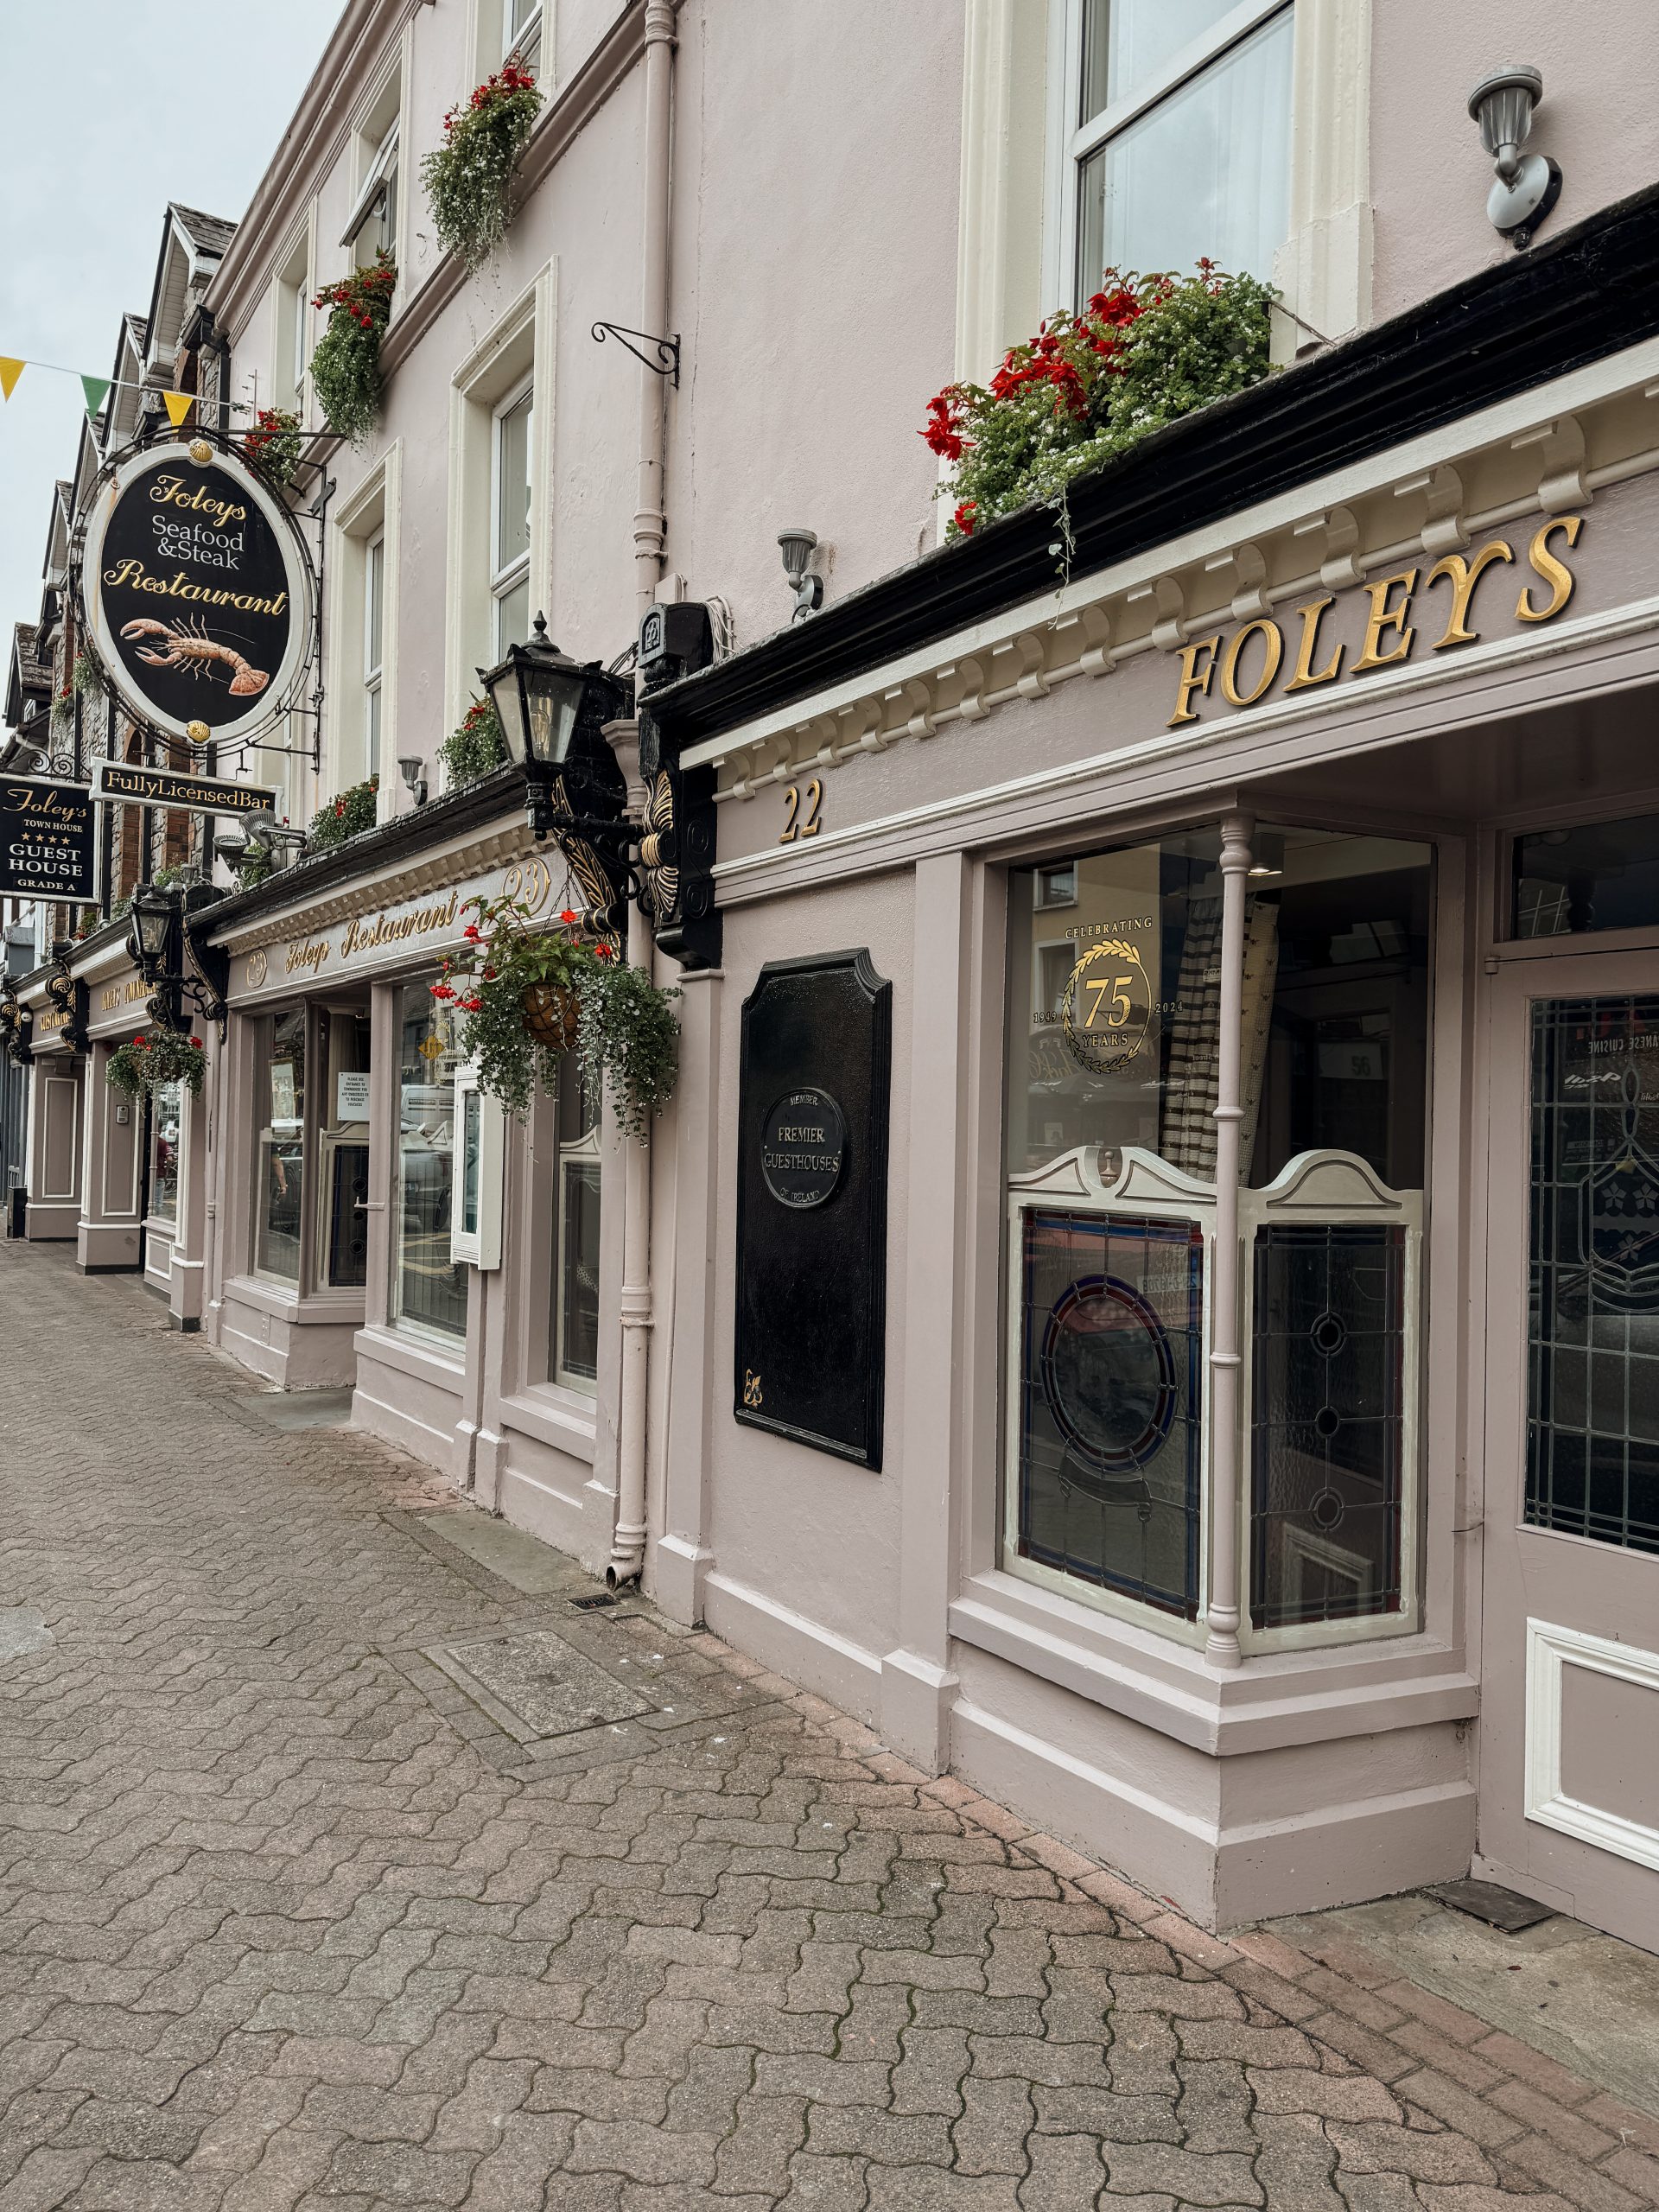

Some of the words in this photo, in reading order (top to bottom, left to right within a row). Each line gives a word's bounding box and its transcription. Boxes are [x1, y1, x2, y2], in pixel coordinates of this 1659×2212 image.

[149, 474, 246, 527] Foleys
[152, 514, 245, 552] Seafood
[157, 537, 240, 570] &Steak
[103, 558, 289, 616] Restaurant
[1166, 516, 1585, 728] FOLEYS
[3, 788, 87, 822] Foley's
[779, 779, 823, 843] 22
[24, 818, 51, 830] TOWN
[53, 823, 83, 833] HOUSE
[10, 843, 81, 861] GUEST
[9, 858, 83, 877] HOUSE
[17, 879, 64, 890] GRADE
[67, 883, 76, 892] A
[340, 891, 459, 959] Restaurant
[1065, 916, 1153, 939] CELEBRATING
[1084, 976, 1134, 1029] 75
[1154, 1001, 1183, 1014] 2024
[1033, 1011, 1057, 1023] 1949
[1082, 1033, 1128, 1048] YEARS
[790, 1094, 818, 1106] MEMBER
[764, 1153, 840, 1173] GUESTHOUSES
[791, 1190, 820, 1203] IRELAND
